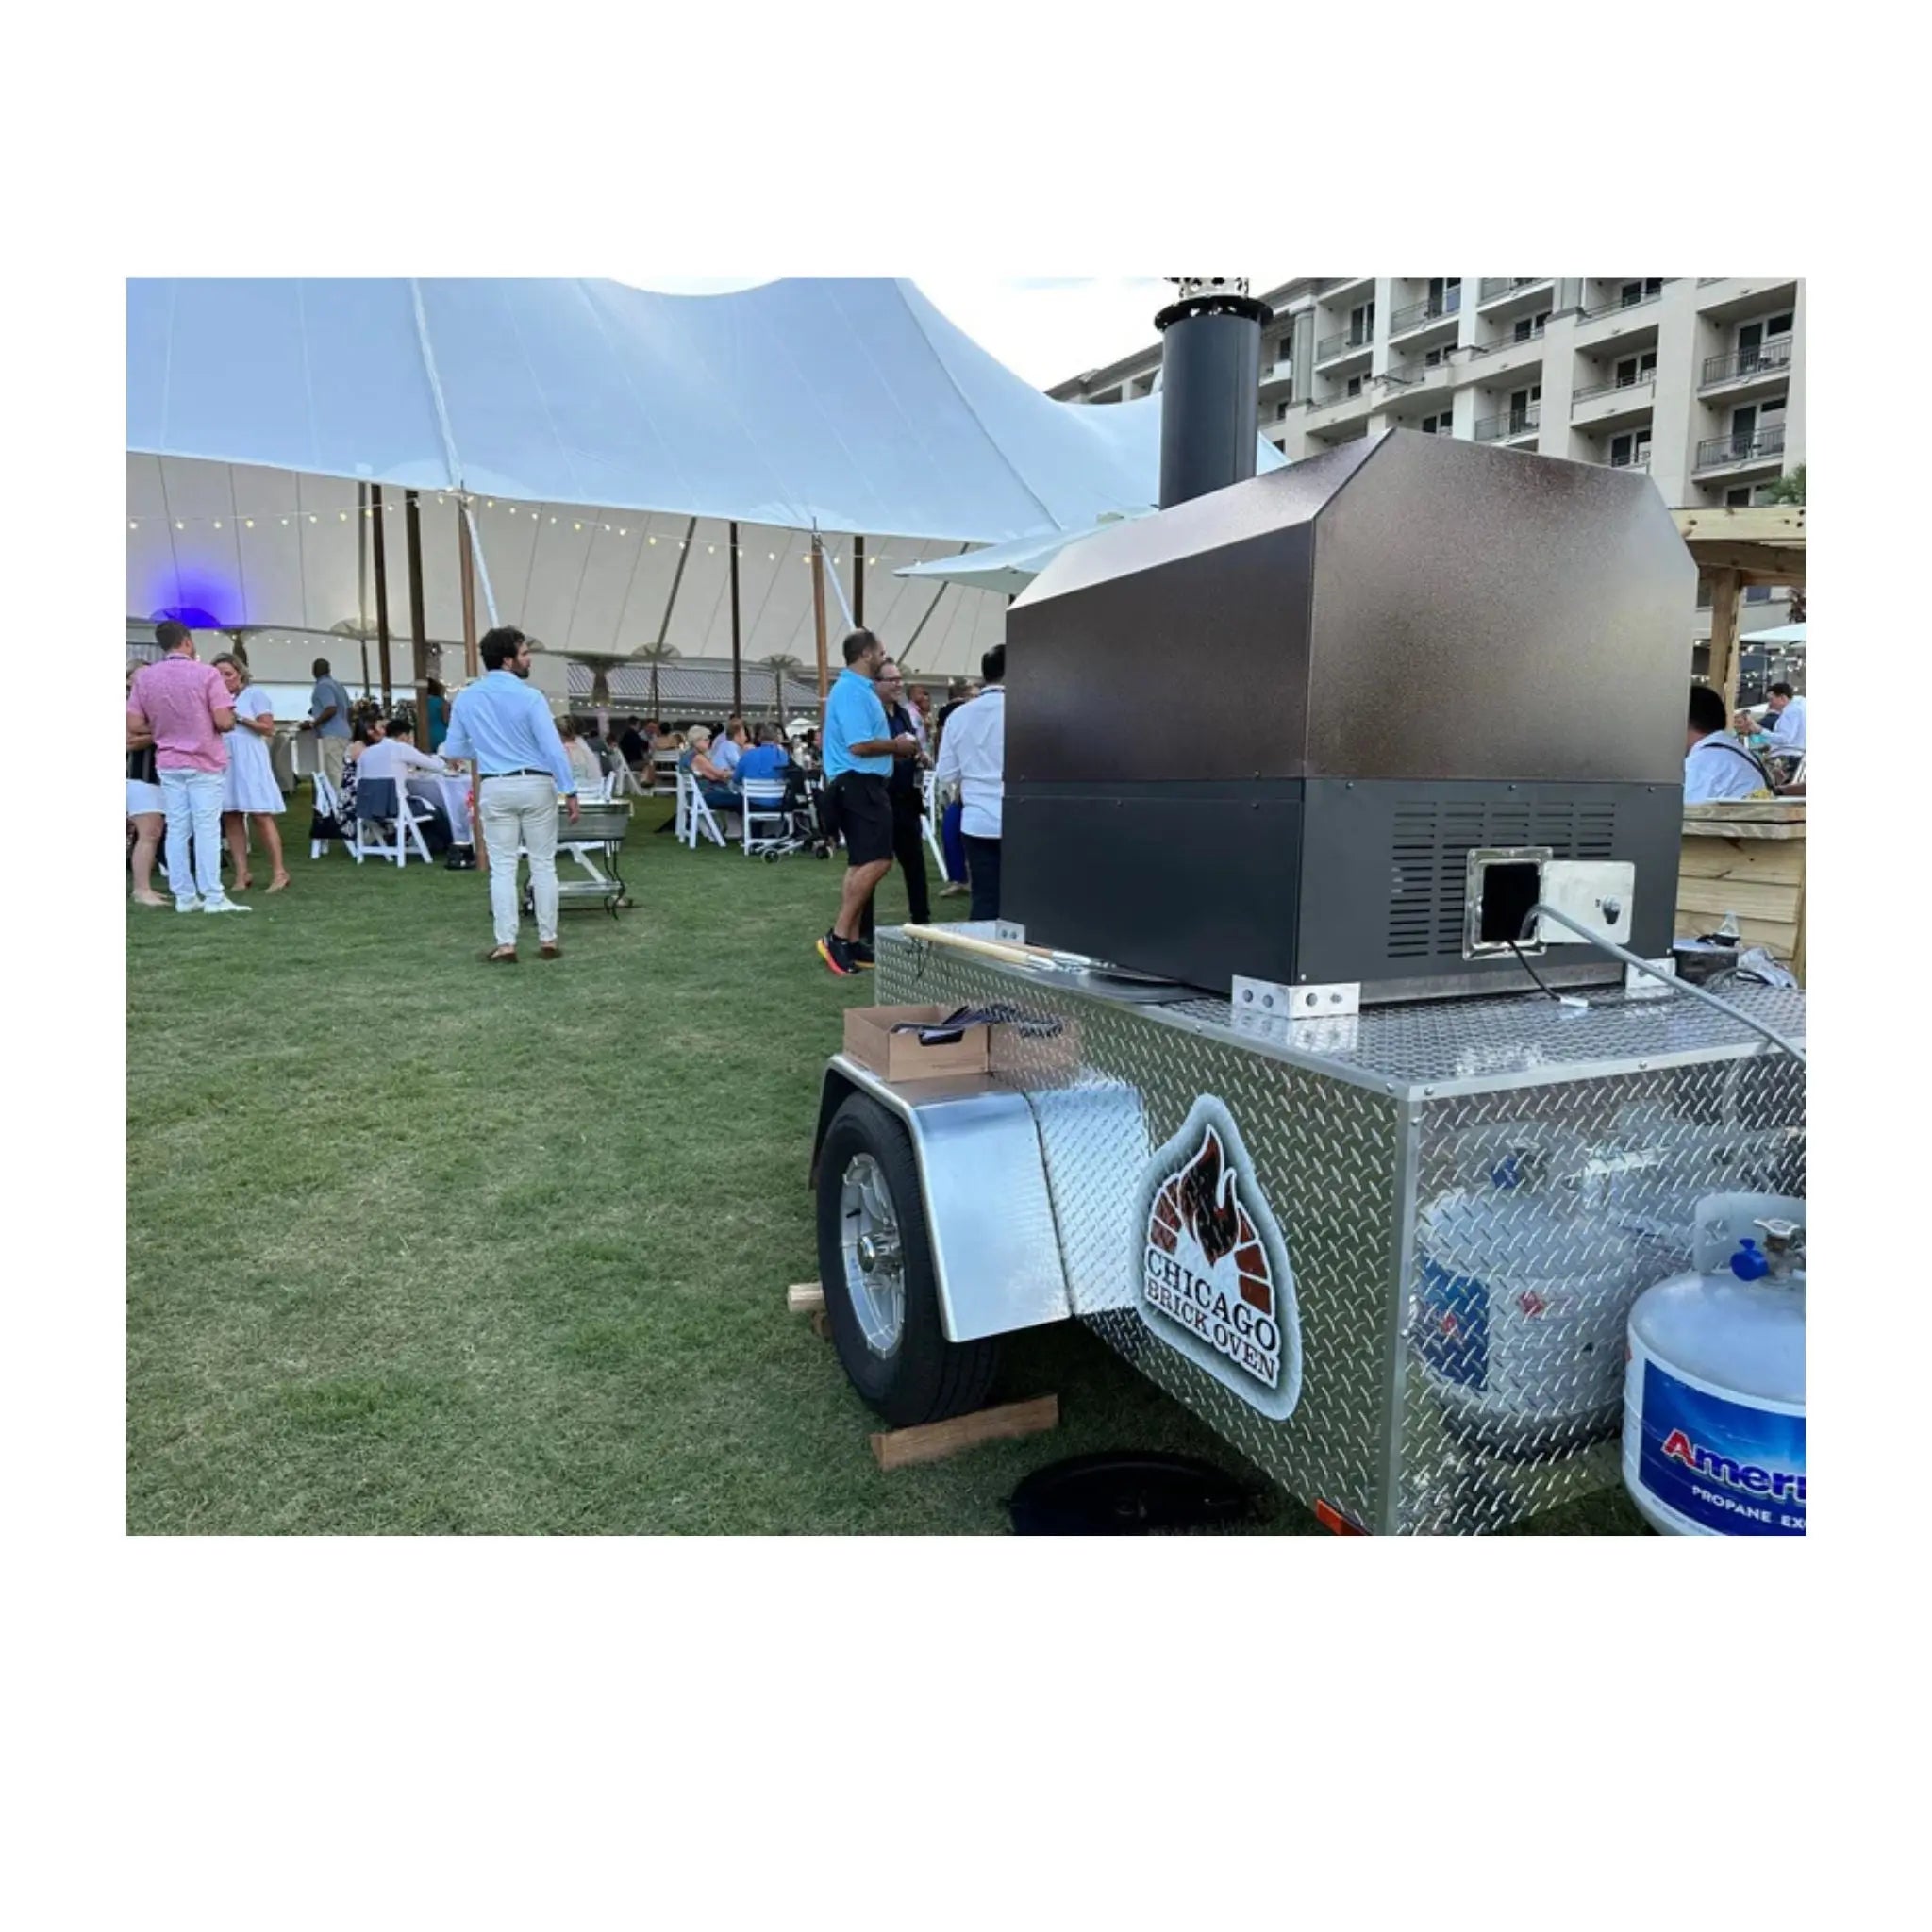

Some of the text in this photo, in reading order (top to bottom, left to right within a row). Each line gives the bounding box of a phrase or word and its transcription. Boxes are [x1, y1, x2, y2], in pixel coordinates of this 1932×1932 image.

[1147, 1248, 1276, 1352] CHICAGO
[1147, 1277, 1276, 1381] BRICK OVEN
[1691, 1484, 1773, 1524] PROPANE
[1780, 1514, 1806, 1530] EX
